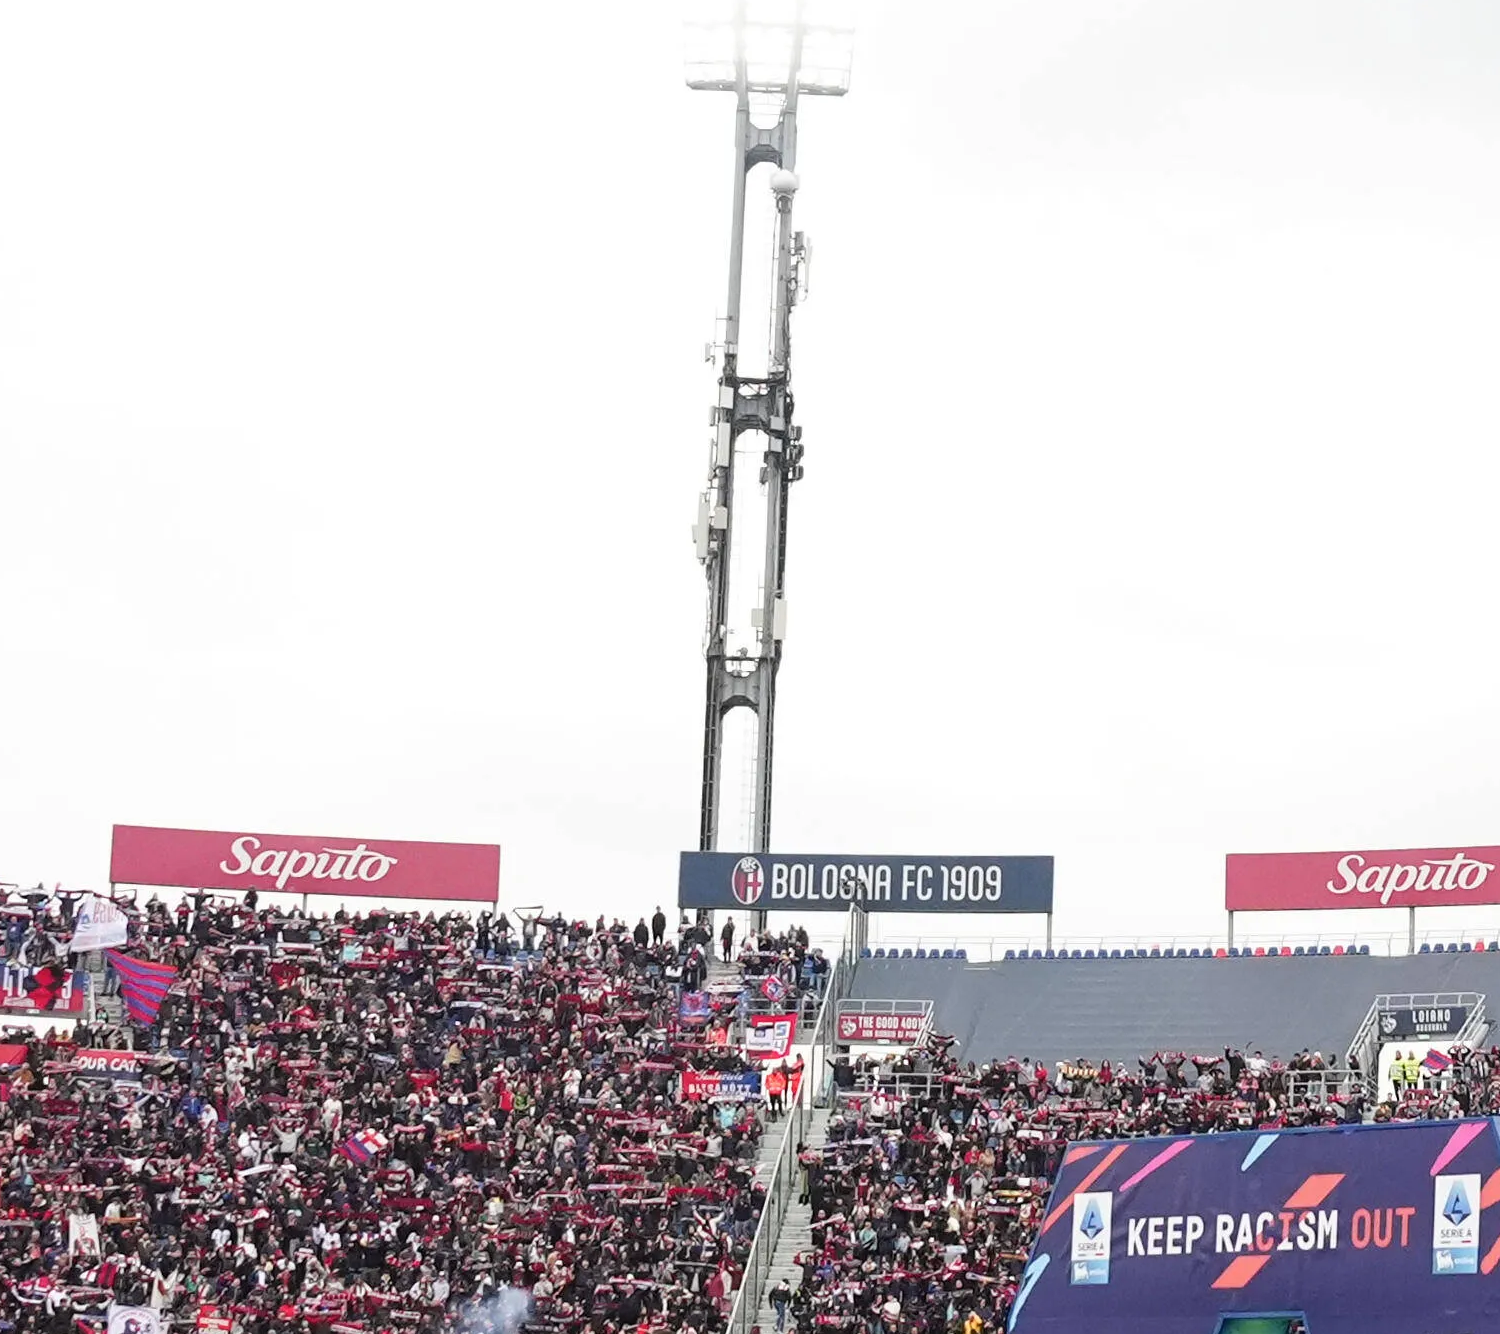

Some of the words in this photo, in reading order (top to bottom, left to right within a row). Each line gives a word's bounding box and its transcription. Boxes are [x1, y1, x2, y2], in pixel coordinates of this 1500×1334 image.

[218, 836, 398, 890] Saputo
[771, 863, 891, 900] BOLOGNA
[902, 865, 933, 901] FC
[942, 865, 1001, 901] 1909
[1326, 853, 1495, 905] Saputo
[858, 1016, 874, 1028] THE
[876, 1017, 899, 1029] GOOD
[1412, 1009, 1451, 1023] LOIANO
[1127, 1215, 1204, 1256] KEEP
[1215, 1210, 1338, 1253] RACISM
[1351, 1207, 1416, 1248] OUT
[1440, 1229, 1461, 1238] SERIE
